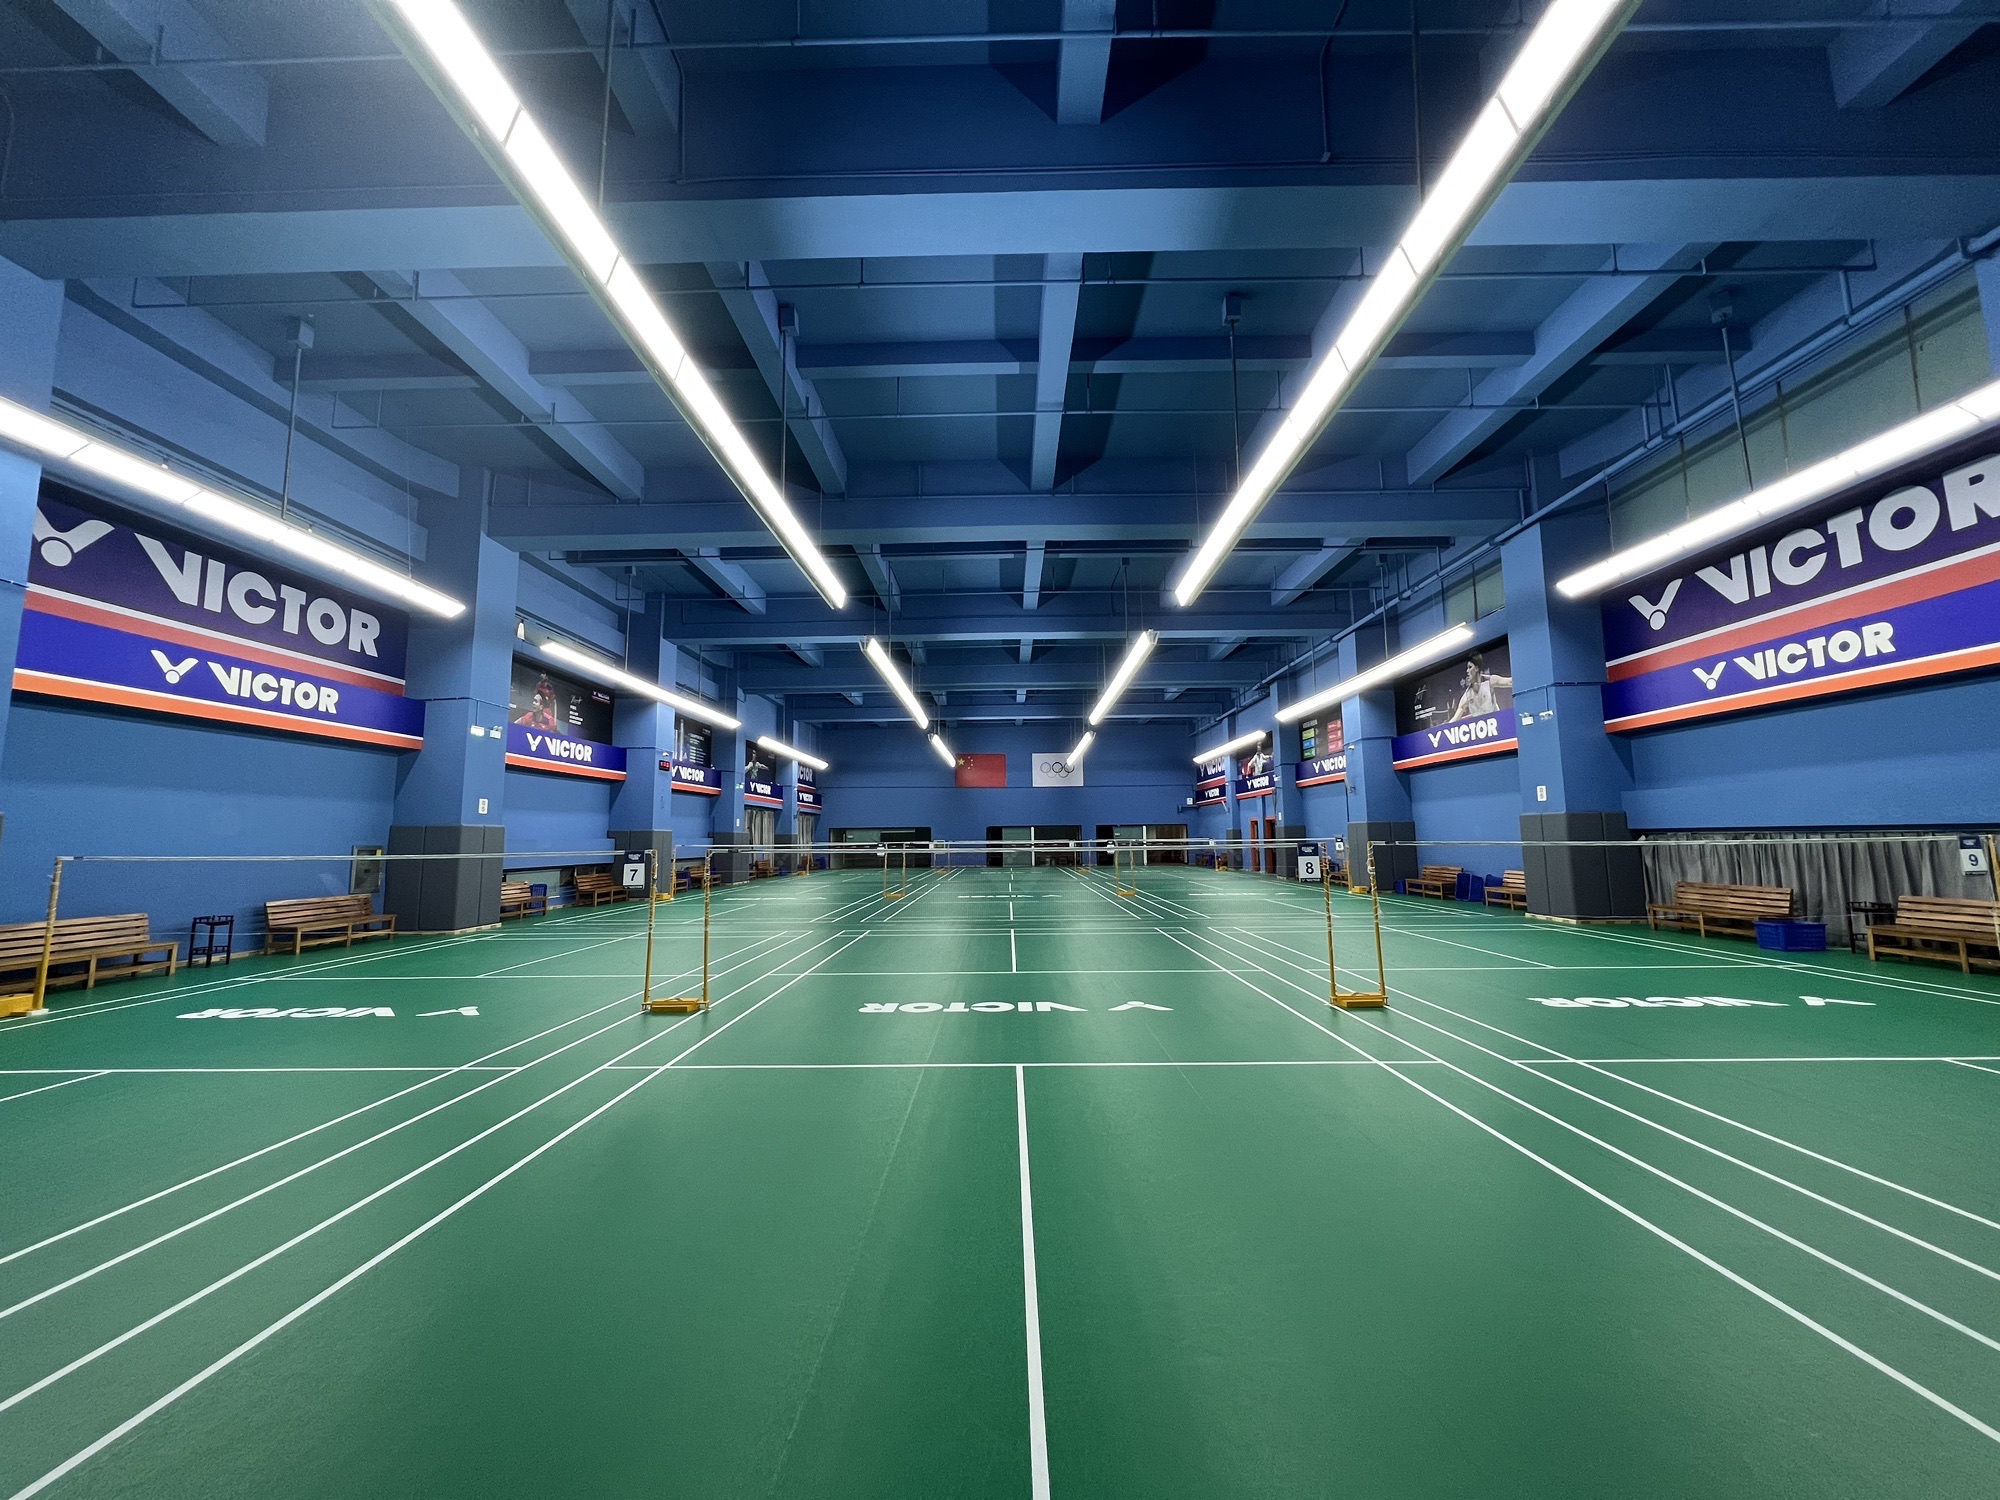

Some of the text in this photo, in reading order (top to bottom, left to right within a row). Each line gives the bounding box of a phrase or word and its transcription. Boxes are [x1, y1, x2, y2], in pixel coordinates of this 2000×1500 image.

[1695, 453, 2000, 605] VICTOR
[134, 532, 381, 657] VICTOR
[1733, 621, 1896, 680] VICTOR
[207, 661, 339, 714] VICTOR
[1444, 718, 1498, 745] VICTOR
[544, 736, 593, 762] VICTOR
[679, 766, 705, 782] VICTOR
[1305, 861, 1315, 875] 8
[1968, 853, 1979, 867] 9
[629, 868, 639, 882] 7
[858, 1001, 1089, 1013] VICTOR
